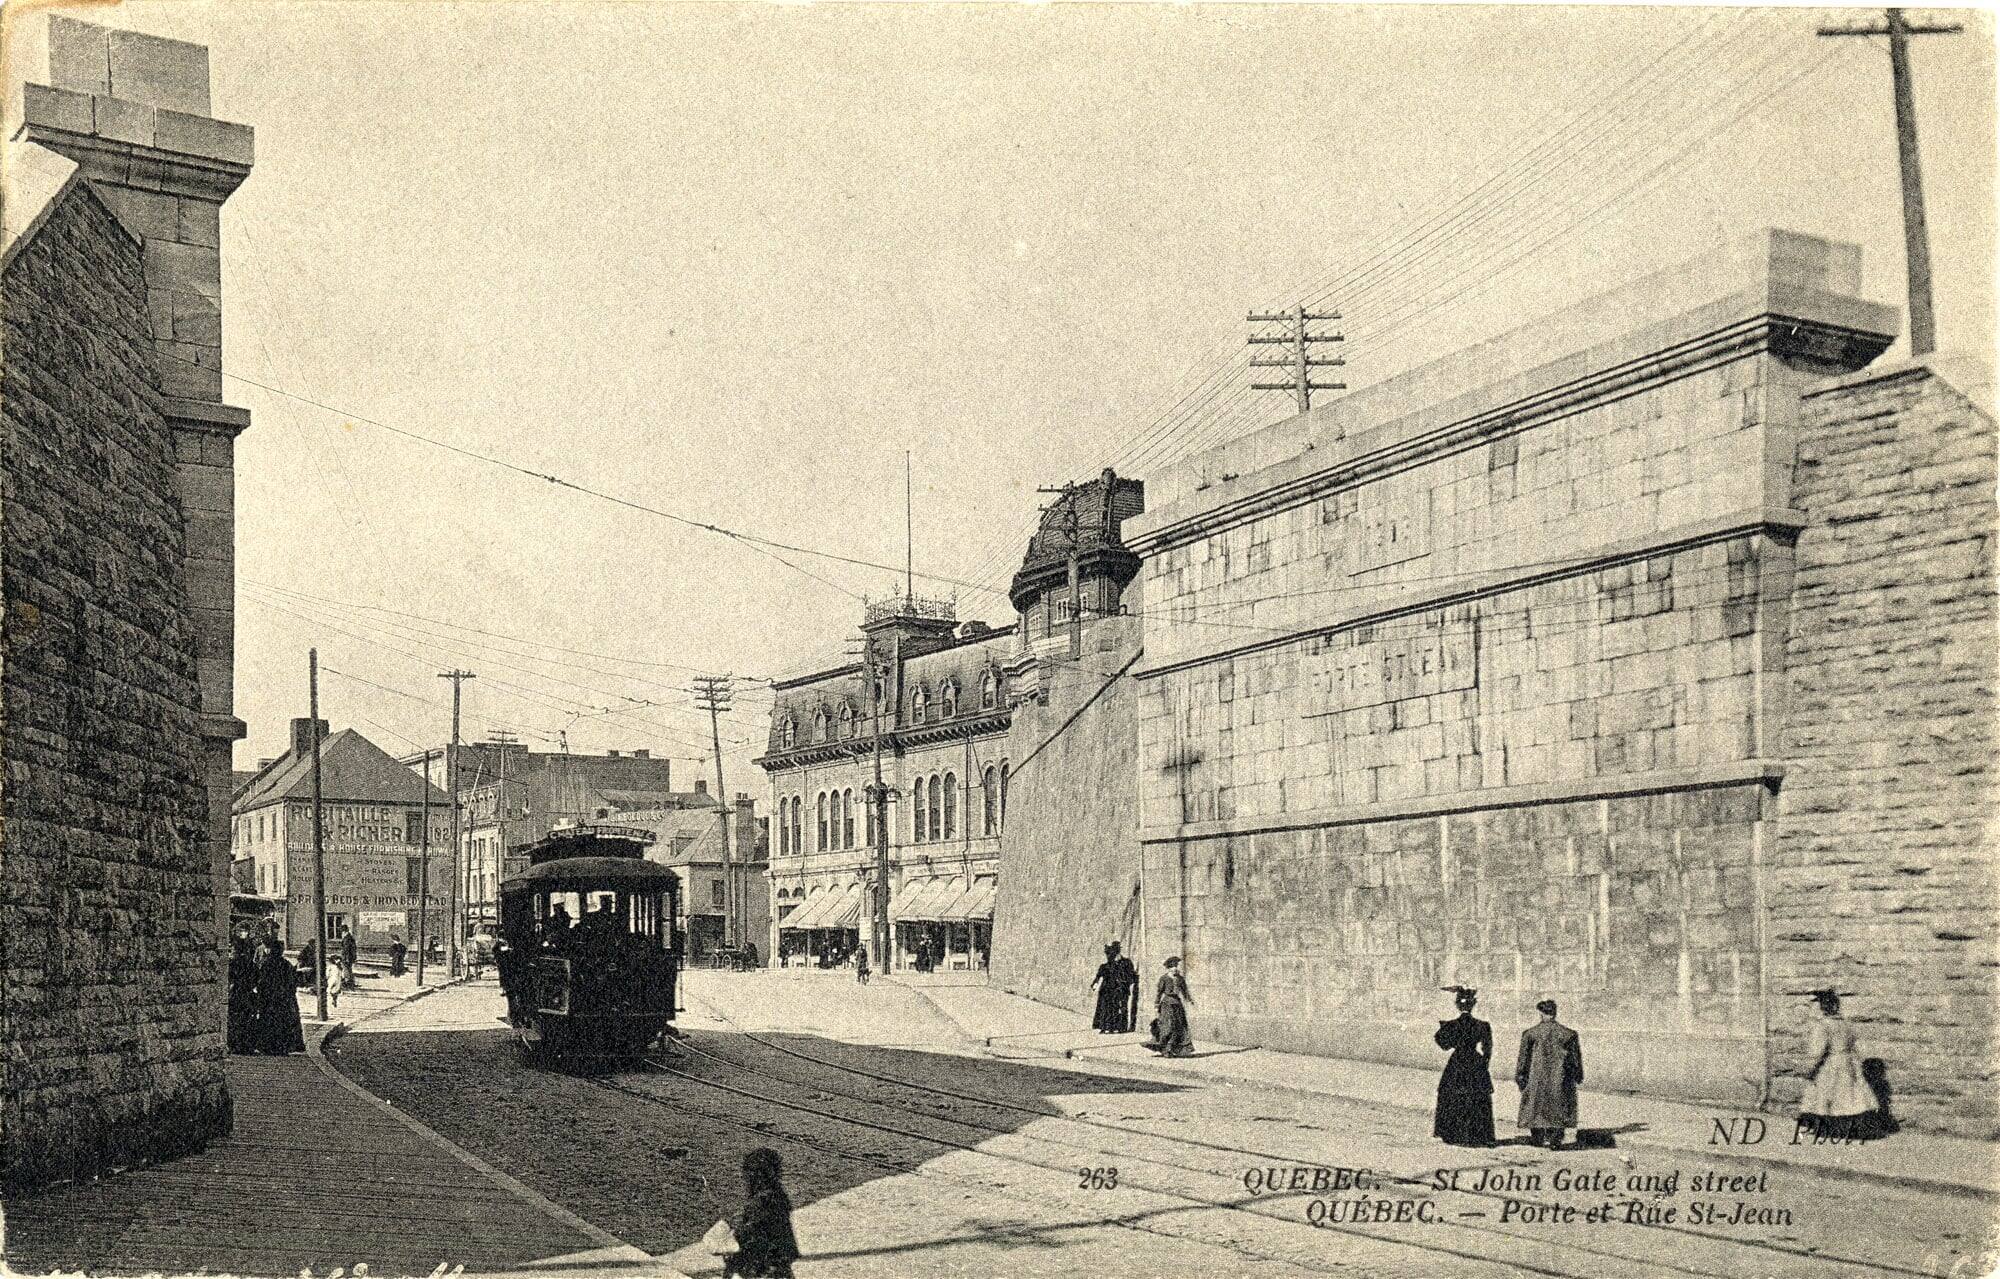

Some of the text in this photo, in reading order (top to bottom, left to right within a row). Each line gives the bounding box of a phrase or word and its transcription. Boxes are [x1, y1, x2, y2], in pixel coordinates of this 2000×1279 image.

[338, 824, 404, 842] RICHER
[339, 844, 366, 853] HOUSE
[332, 894, 359, 905] BEDS
[360, 895, 371, 905] &
[374, 895, 400, 906] IRON
